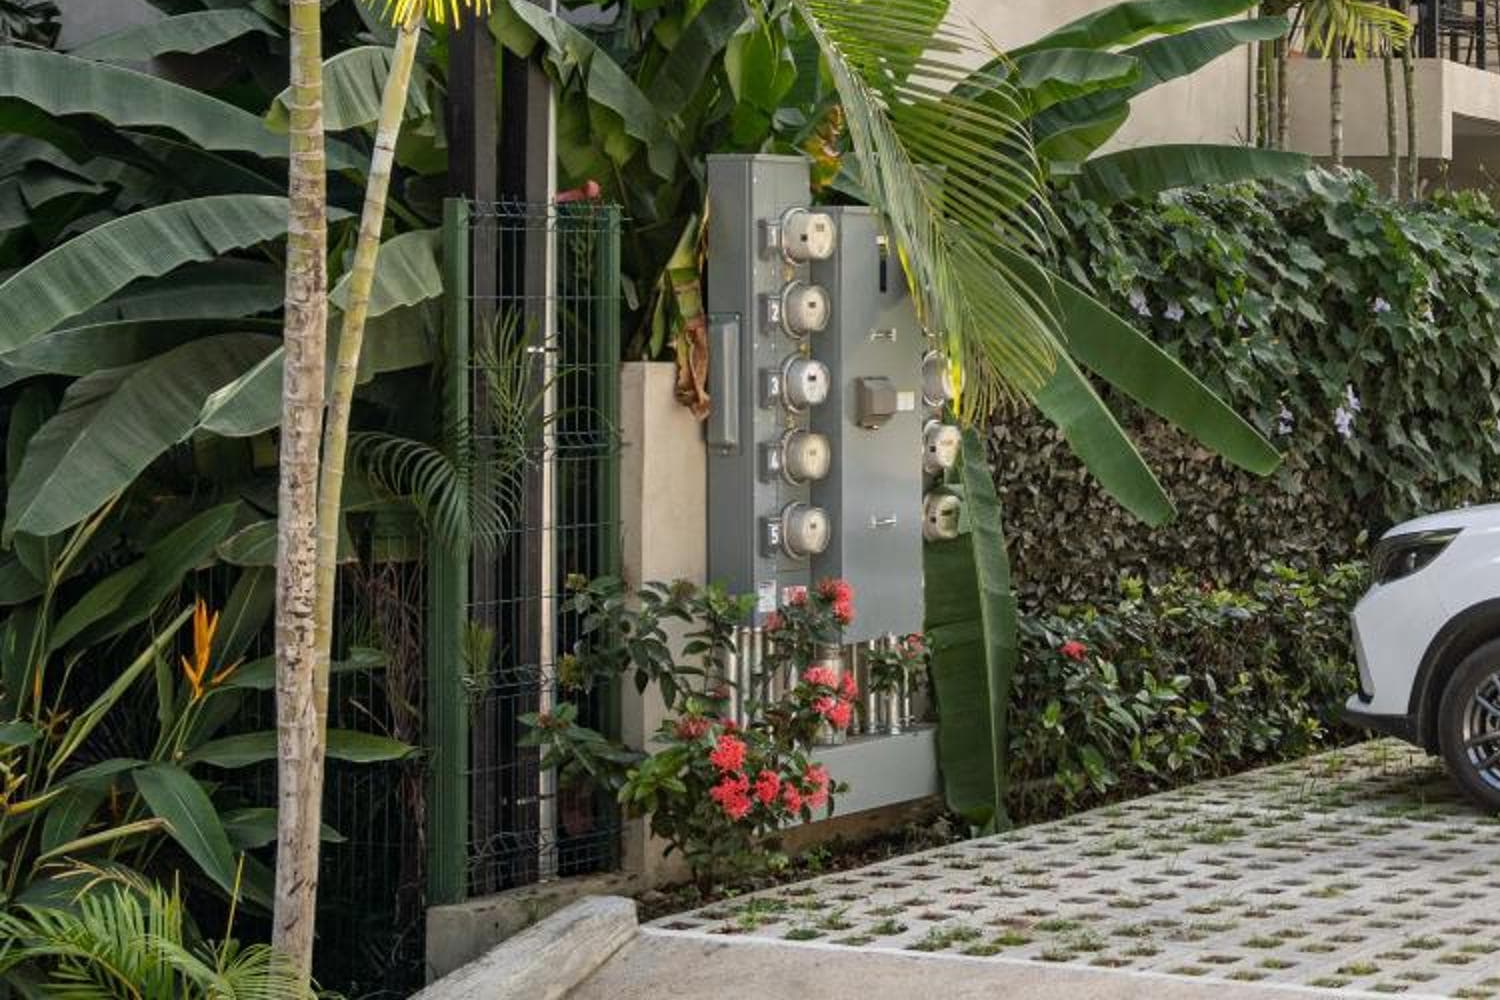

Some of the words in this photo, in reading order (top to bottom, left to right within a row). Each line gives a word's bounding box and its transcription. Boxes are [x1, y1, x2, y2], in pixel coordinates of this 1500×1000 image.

[770, 303, 779, 322] 2
[771, 376, 779, 395] 3
[771, 450, 779, 470] 4
[771, 525, 779, 545] 5
